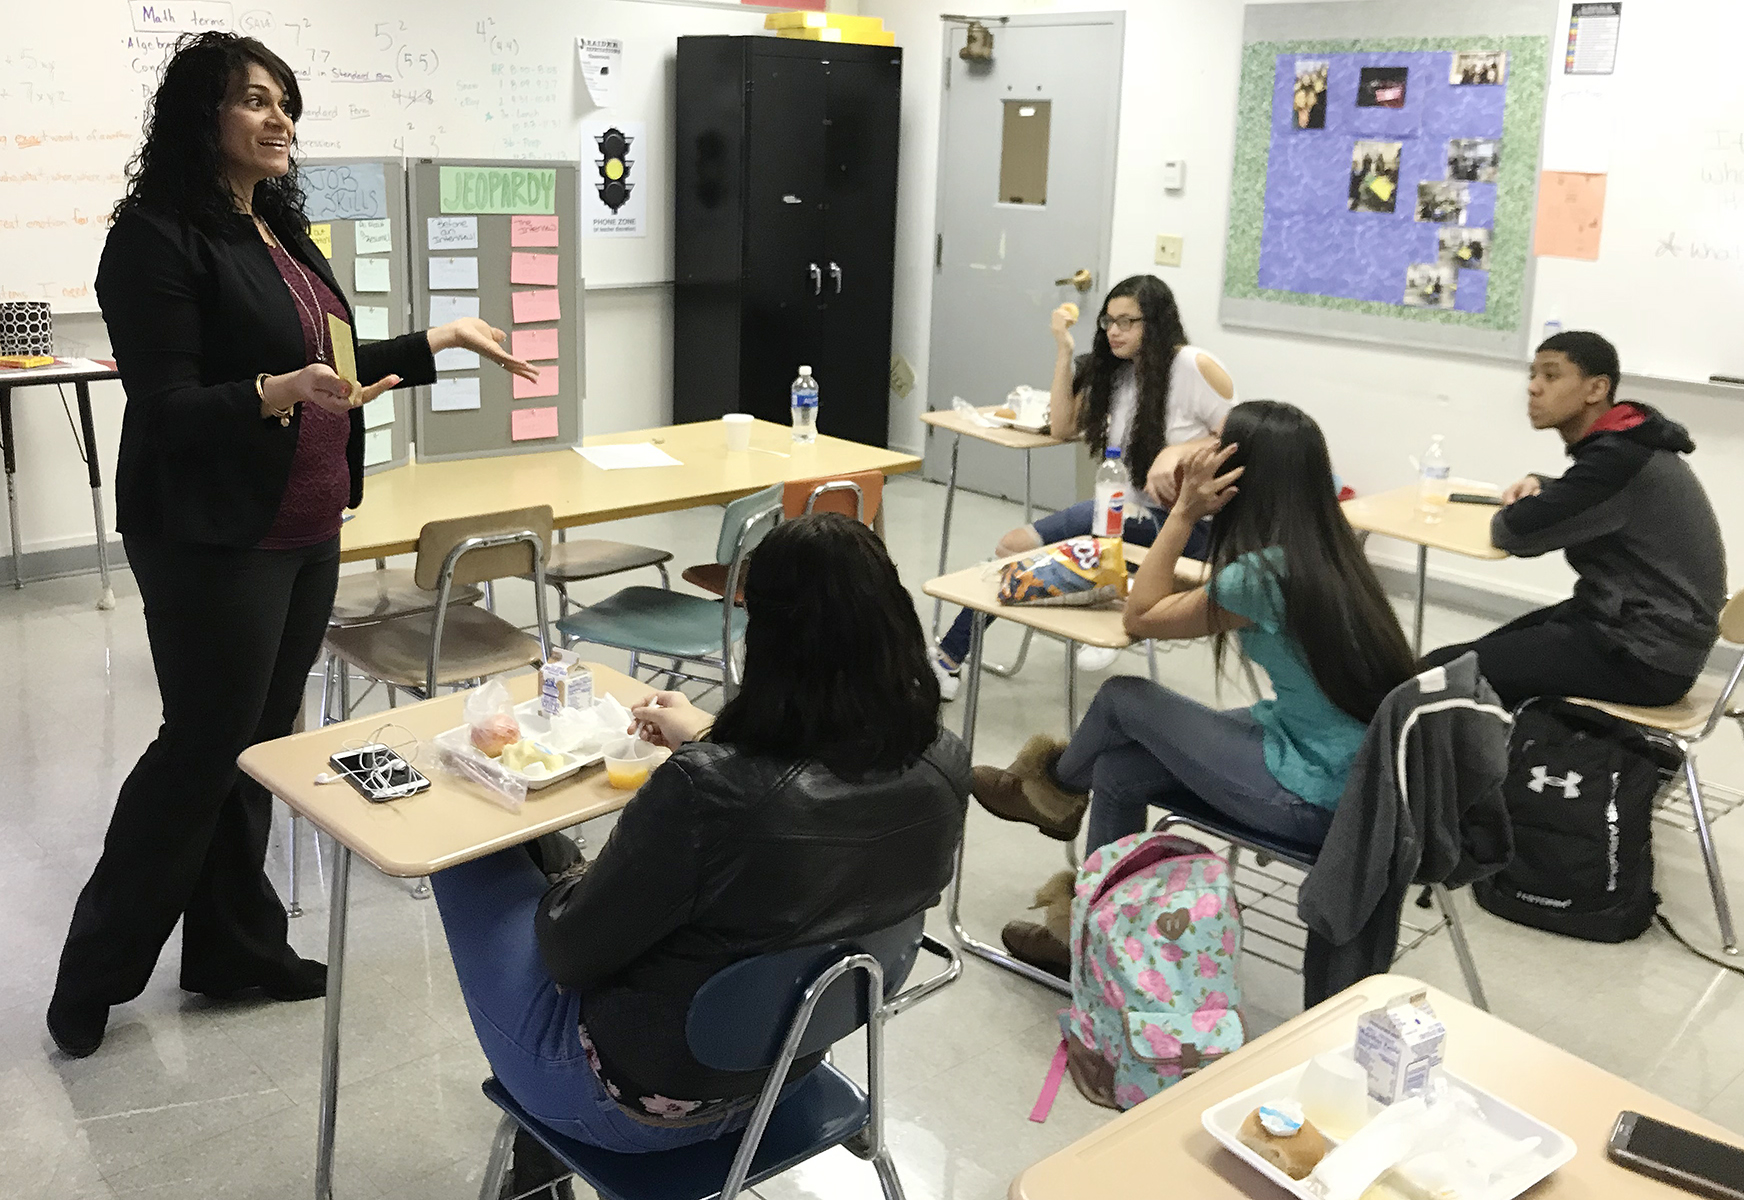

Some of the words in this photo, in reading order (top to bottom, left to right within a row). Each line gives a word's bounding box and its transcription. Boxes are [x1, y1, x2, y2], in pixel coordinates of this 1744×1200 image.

[142, 5, 176, 23] Math
[190, 10, 226, 26] terms
[443, 170, 556, 211] JEOPARDY
[320, 188, 378, 220] SKILLS
[593, 218, 616, 226] PHONE
[618, 218, 636, 226] ZONE
